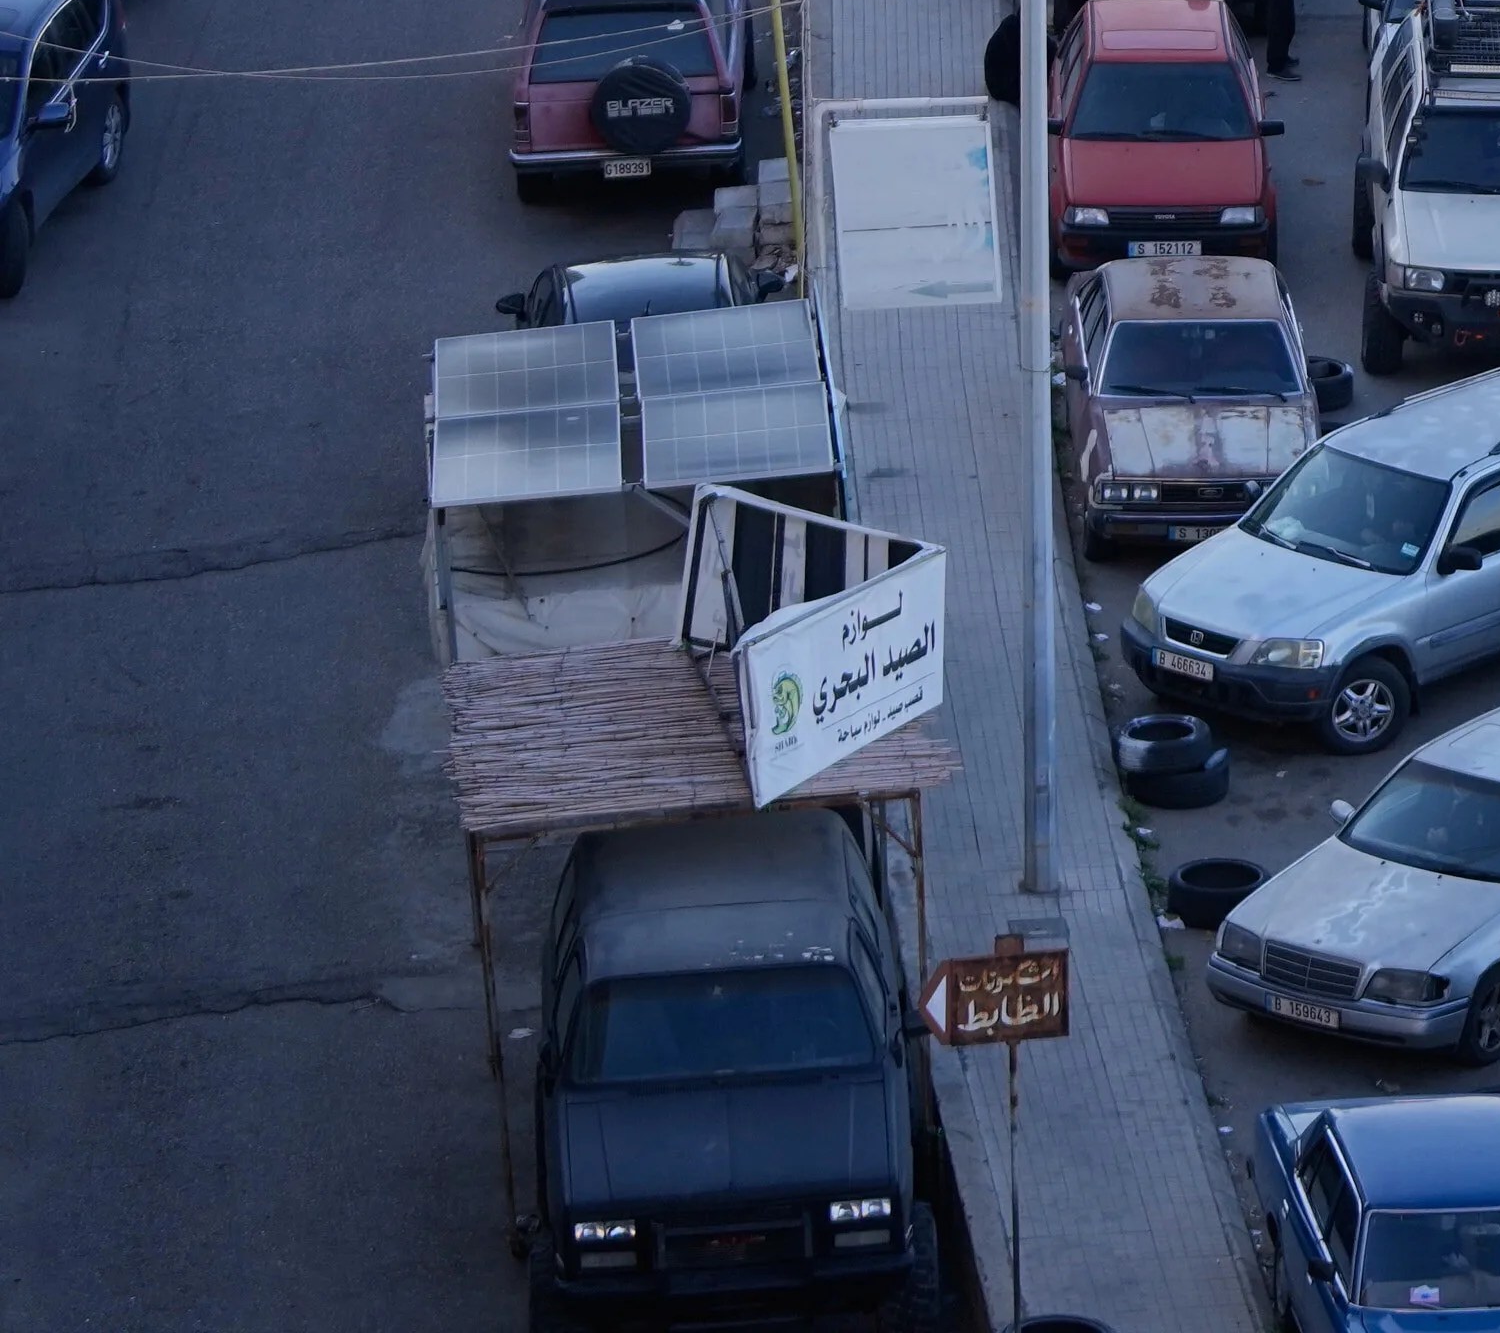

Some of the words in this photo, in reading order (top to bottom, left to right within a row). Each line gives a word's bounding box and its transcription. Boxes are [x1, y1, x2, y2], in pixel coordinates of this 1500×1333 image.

[606, 97, 674, 113] BLAZER
[605, 161, 651, 176] G189391
[1137, 242, 1145, 255] S
[1153, 241, 1194, 254] 152112
[1179, 527, 1187, 539] S
[841, 589, 903, 651] لوازم
[882, 618, 936, 681] الصيد
[1158, 652, 1166, 666] B
[1170, 657, 1207, 678] 466634
[812, 648, 876, 725] البحري
[957, 991, 1062, 1036] الظابط
[1274, 999, 1282, 1012] B
[1289, 1002, 1332, 1023] 159643
